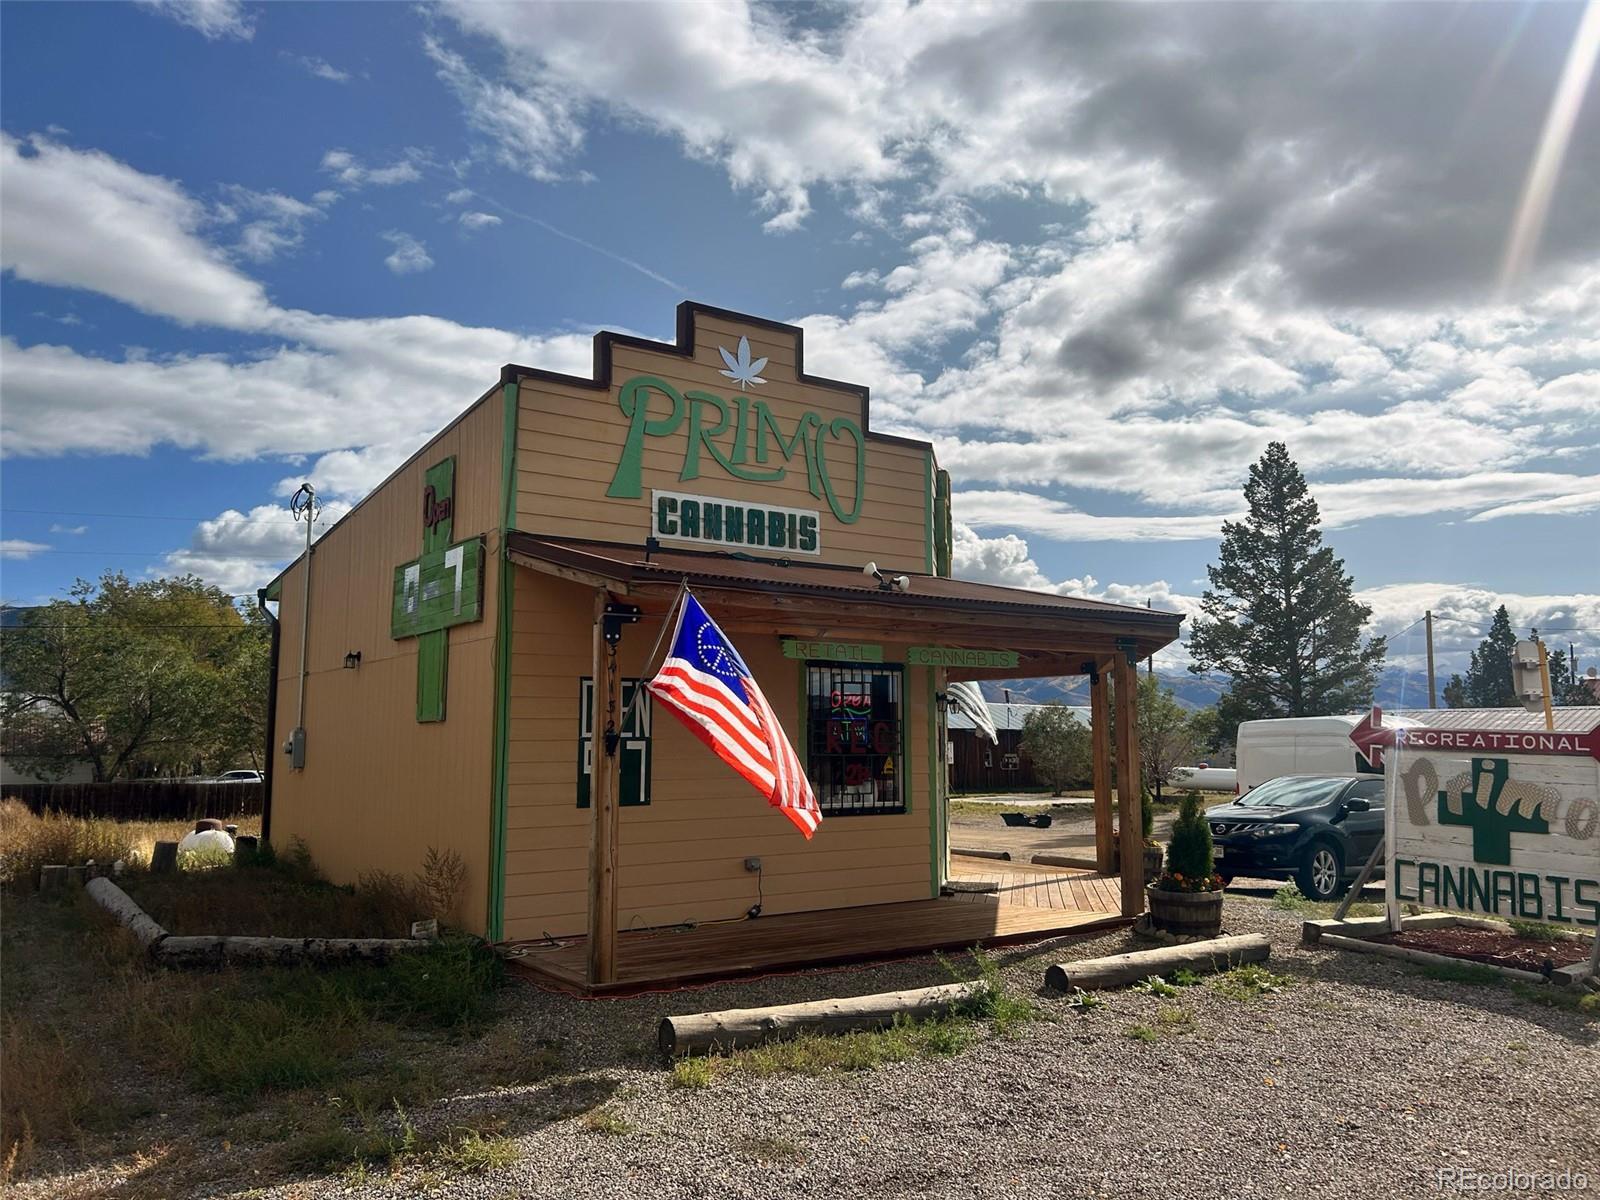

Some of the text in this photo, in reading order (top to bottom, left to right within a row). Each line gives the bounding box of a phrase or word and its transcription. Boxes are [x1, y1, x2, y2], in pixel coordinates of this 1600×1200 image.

[606, 376, 865, 524] PRIMO
[424, 485, 450, 535] Open
[658, 497, 817, 551] CANNABIS
[795, 643, 873, 661] RETAIL
[919, 649, 1011, 667] CANNABIS
[1395, 730, 1590, 751] RECREATIONAL
[1395, 858, 1600, 925] CANNABIS
